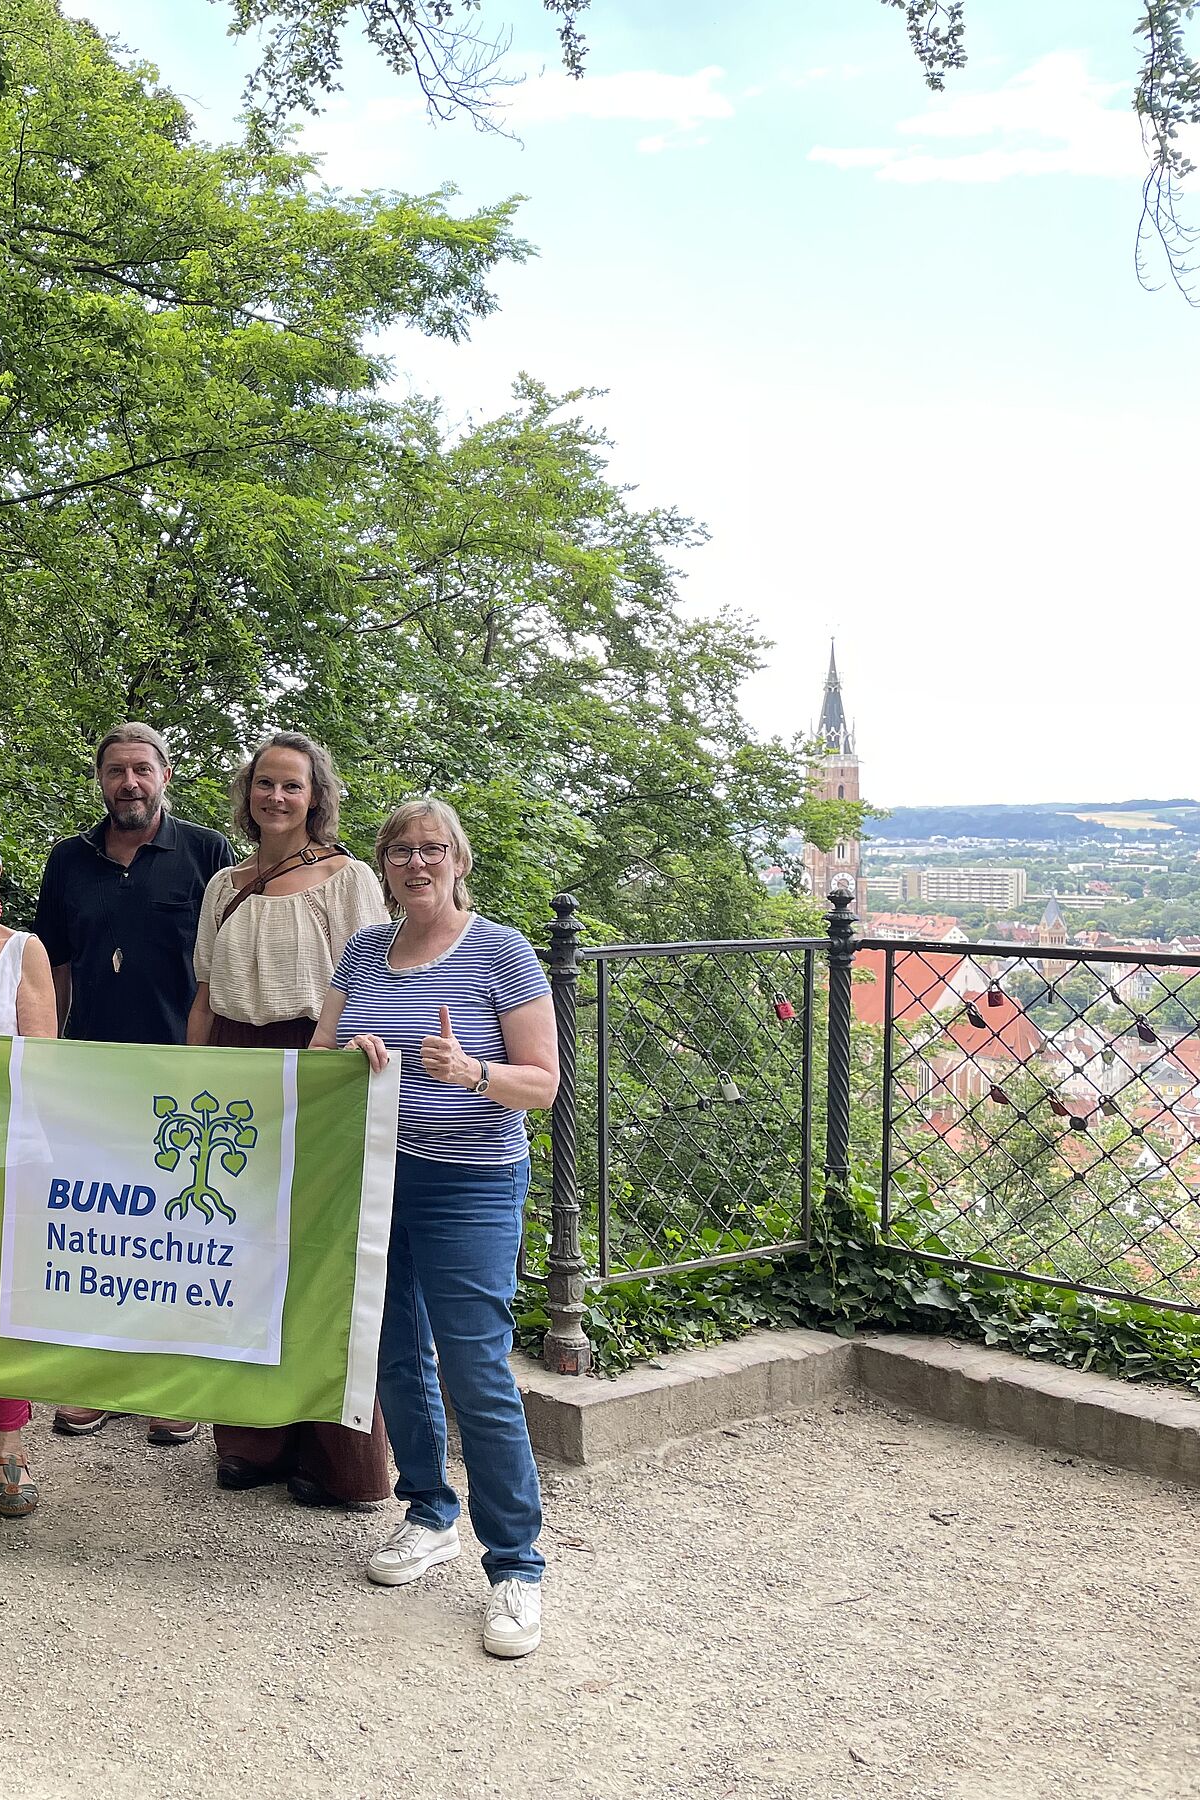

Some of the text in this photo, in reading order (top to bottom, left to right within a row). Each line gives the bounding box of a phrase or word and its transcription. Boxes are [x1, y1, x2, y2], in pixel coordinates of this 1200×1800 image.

[47, 1178, 156, 1216] BUND
[47, 1222, 234, 1266] Naturschutz
[45, 1261, 235, 1307] in Bayern e.V.
